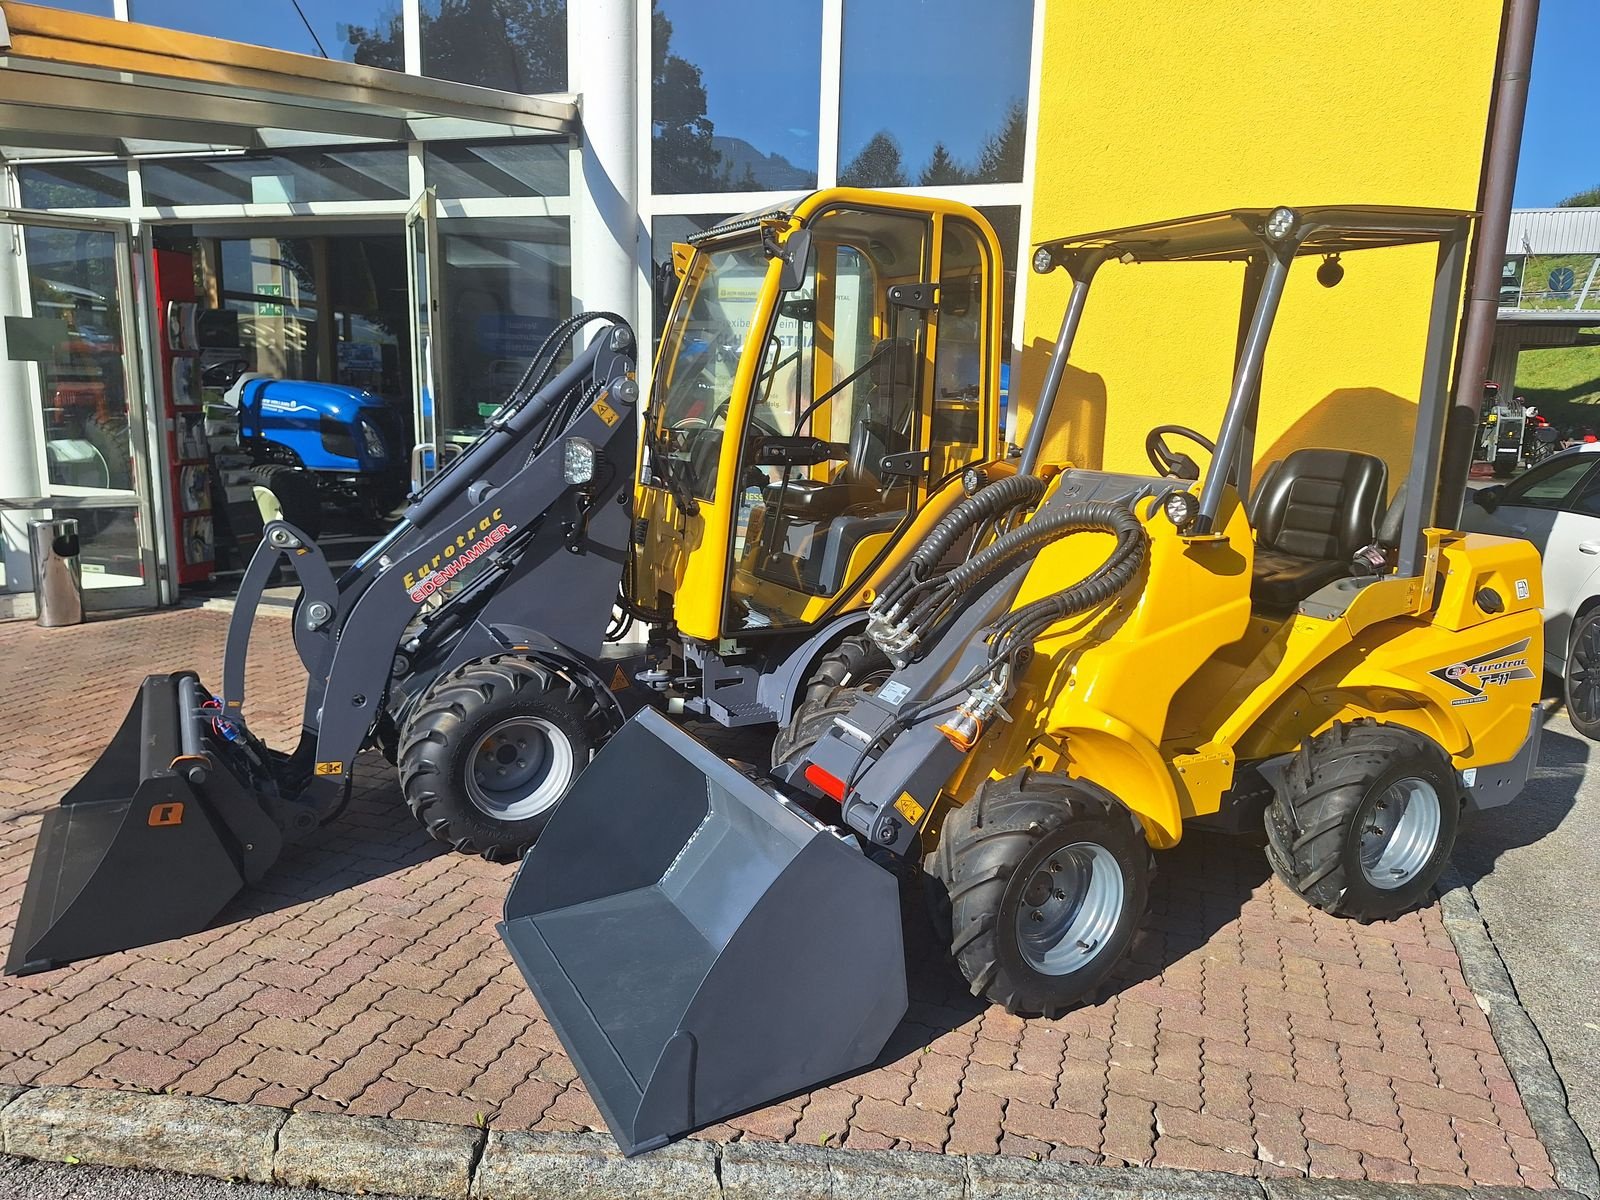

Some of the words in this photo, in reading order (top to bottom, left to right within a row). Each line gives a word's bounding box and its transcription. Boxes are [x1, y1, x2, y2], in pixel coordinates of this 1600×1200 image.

[743, 492, 764, 502] RESS
[403, 508, 502, 590] Eurotrac
[411, 523, 511, 603] EIDENHAMMER
[1470, 658, 1527, 673] Eurotrac
[1480, 672, 1511, 689] T-11
